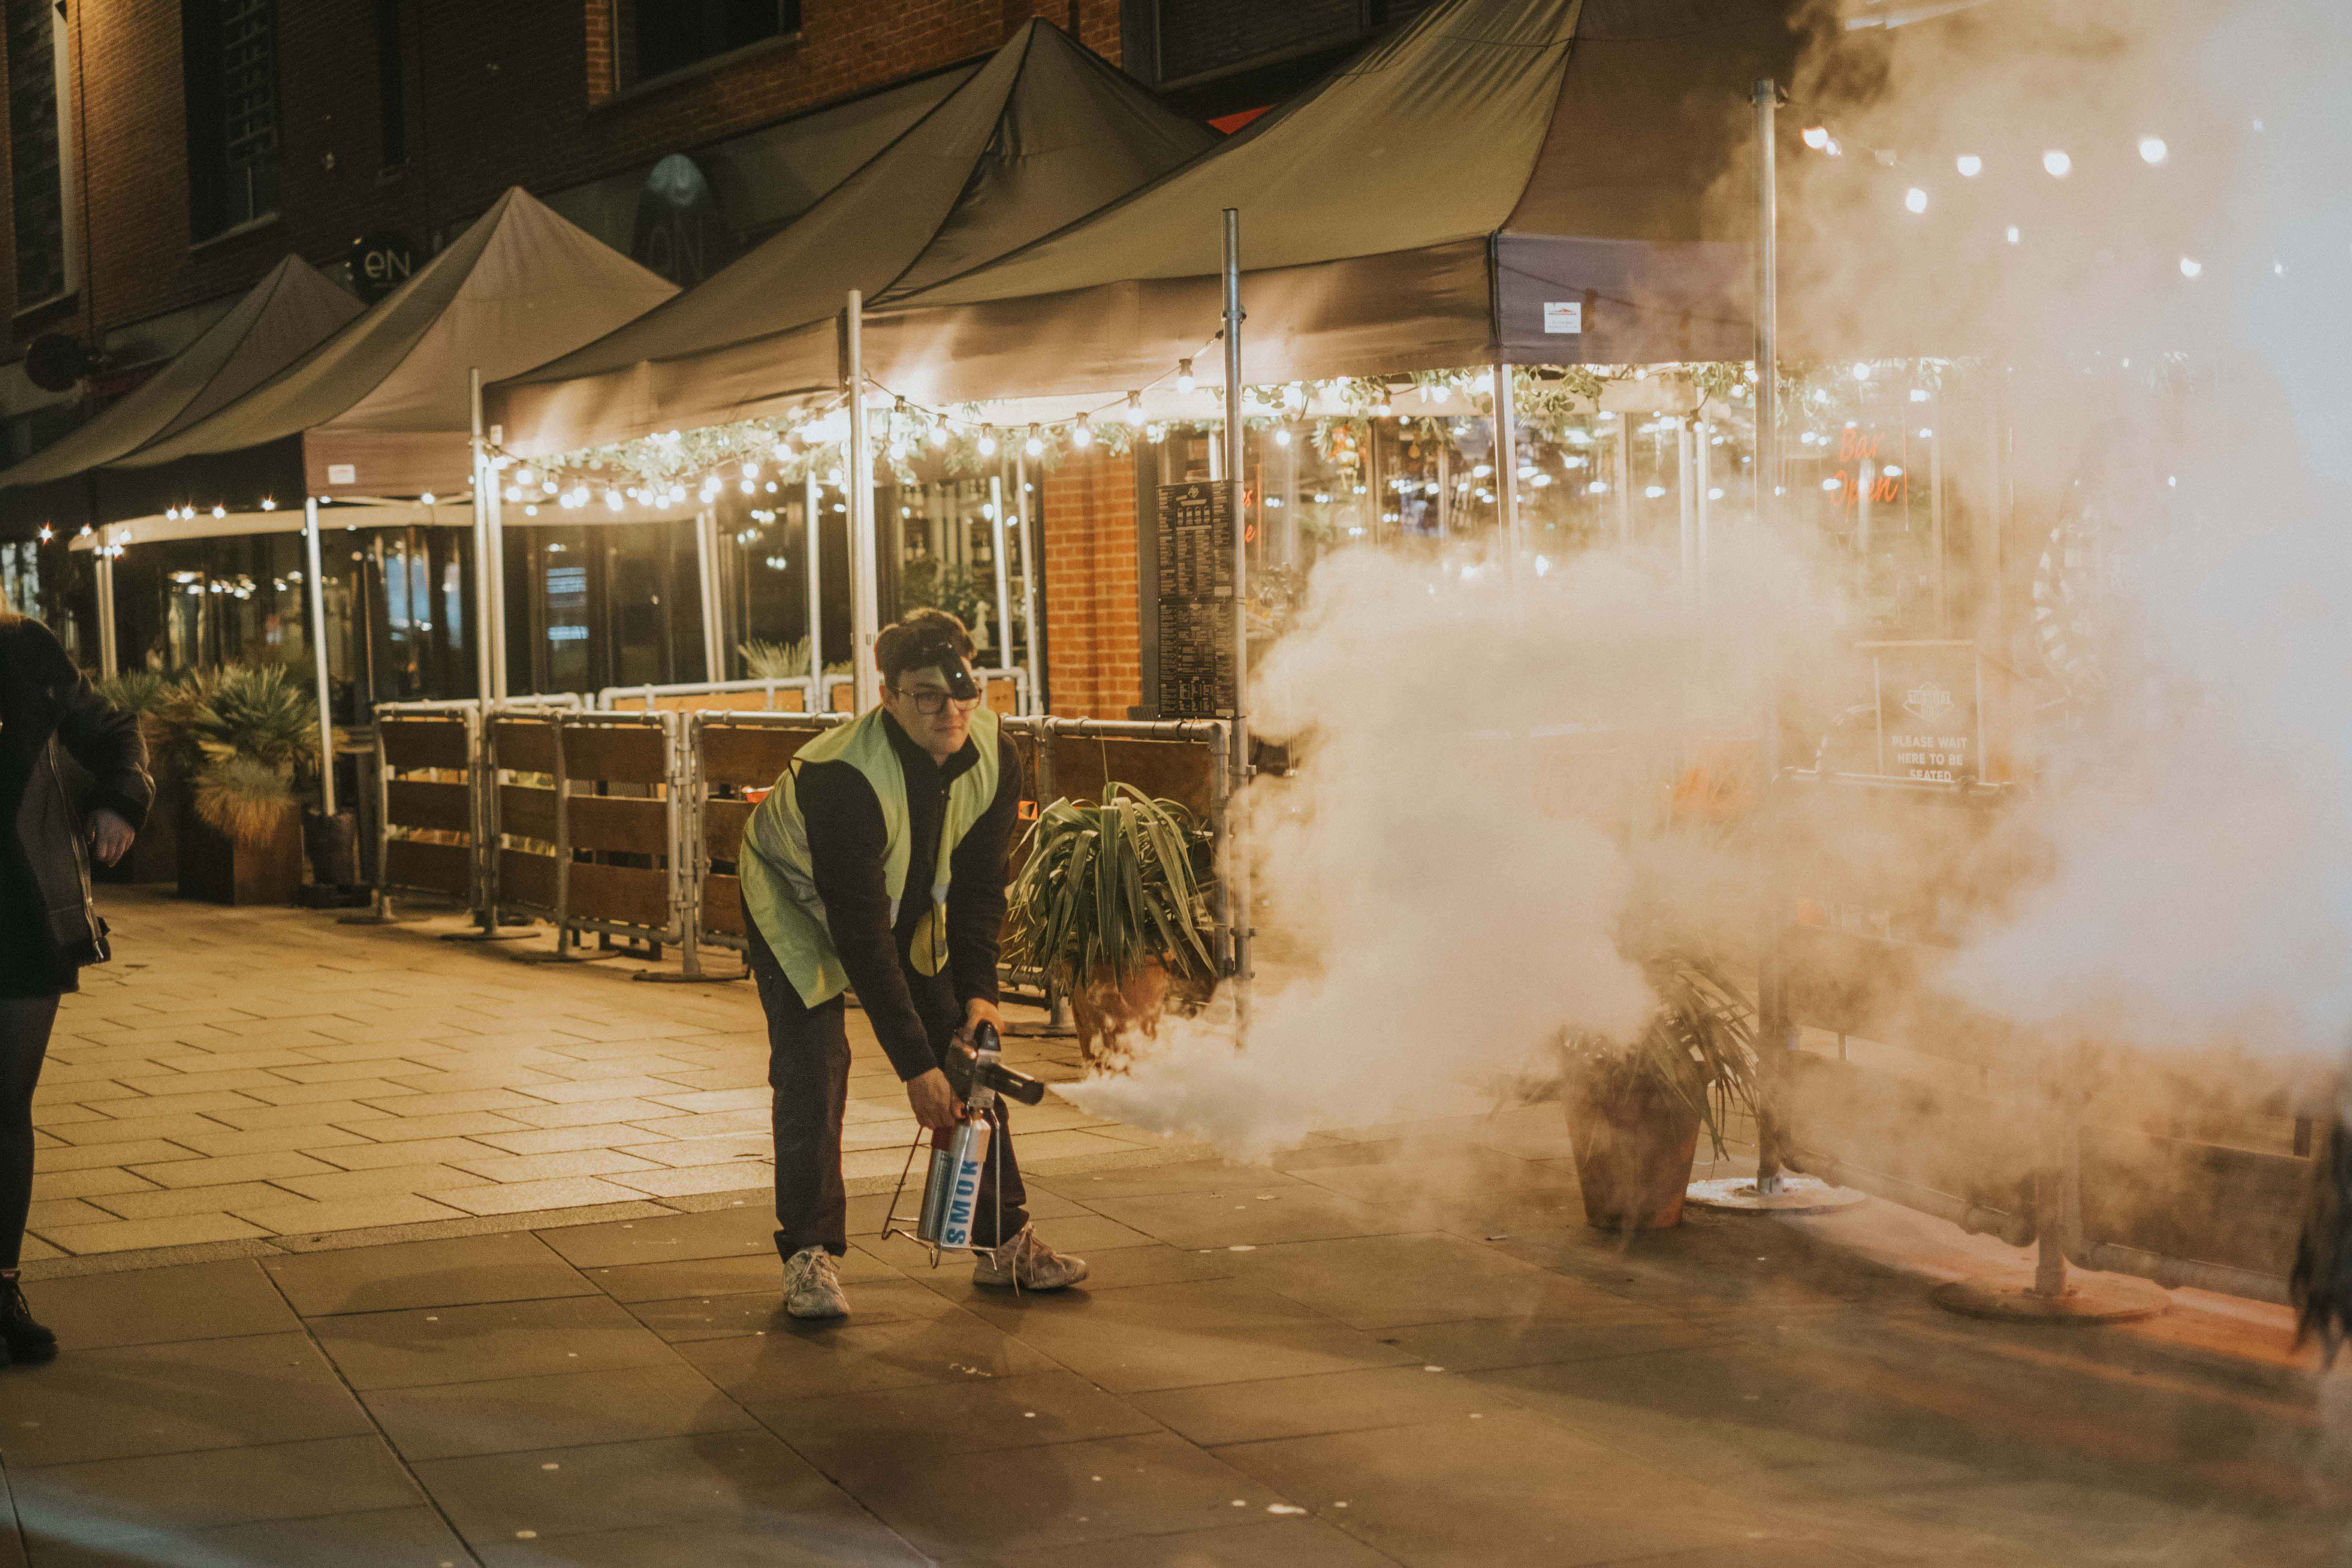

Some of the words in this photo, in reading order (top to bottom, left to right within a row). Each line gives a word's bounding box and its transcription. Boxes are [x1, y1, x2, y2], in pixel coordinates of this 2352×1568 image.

[364, 249, 410, 280] eN
[1891, 735, 1934, 748] PLEASE
[1938, 737, 1967, 749] WAIT
[1897, 753, 1926, 764] HERE
[1929, 753, 1945, 766] TO
[1948, 754, 1963, 766] BE
[1909, 769, 1952, 781] SEATED
